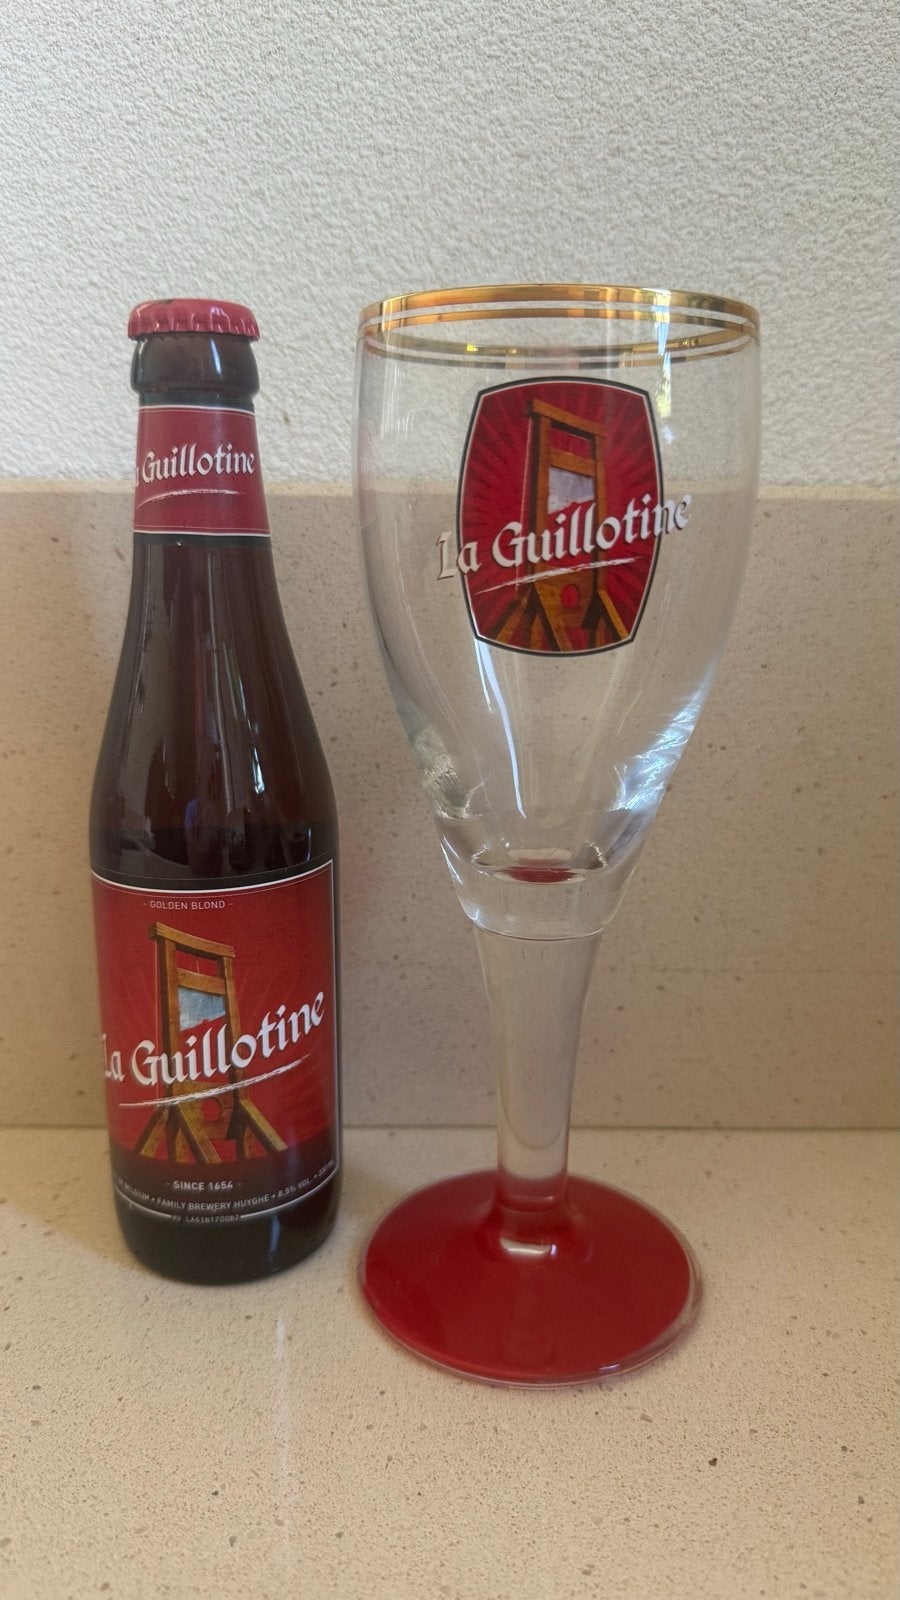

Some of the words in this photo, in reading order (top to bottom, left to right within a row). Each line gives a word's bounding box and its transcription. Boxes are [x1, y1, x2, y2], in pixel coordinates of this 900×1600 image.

[142, 442, 255, 484] Guillotine
[436, 531, 482, 581] La
[492, 493, 693, 568] Guillotine
[150, 900, 188, 910] GOLDEN
[191, 900, 226, 910] BLOND
[131, 991, 325, 1087] Guillotine
[173, 1180, 205, 1191] SINCE
[208, 1180, 234, 1191] 1654
[157, 1197, 186, 1209] FAMILY
[188, 1201, 232, 1211] BREWERY
[234, 1194, 270, 1209] HUYGHE
